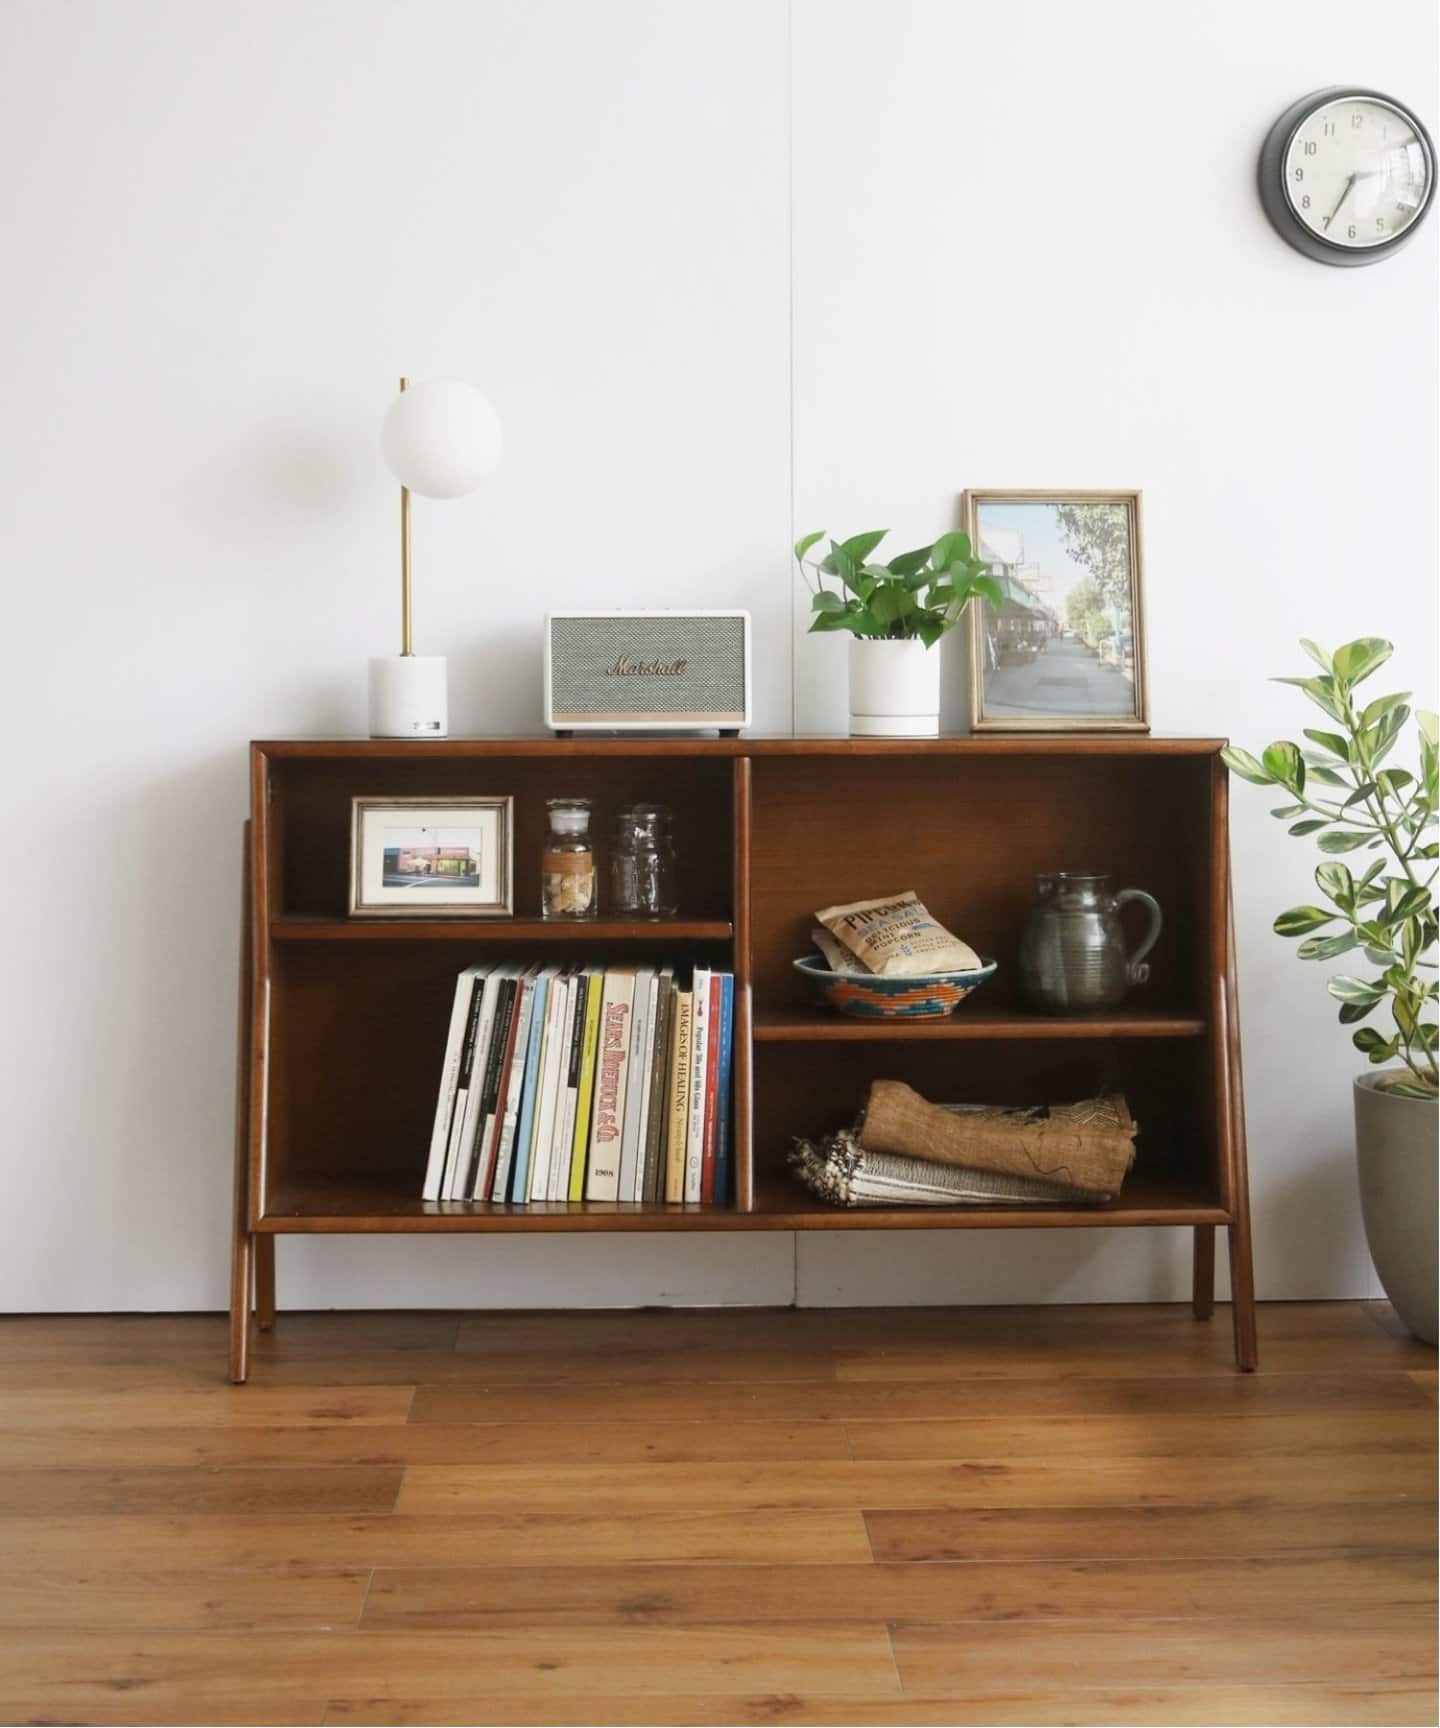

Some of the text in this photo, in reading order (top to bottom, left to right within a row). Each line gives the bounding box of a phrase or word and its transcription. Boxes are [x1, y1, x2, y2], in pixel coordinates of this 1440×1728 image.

[1351, 114, 1363, 129] 12
[1324, 123, 1335, 137] 11
[1304, 141, 1317, 155] 10
[1295, 167, 1304, 182] 9
[1302, 195, 1311, 209] 8
[1322, 216, 1331, 231] 7
[1376, 218, 1385, 232] 5
[1348, 225, 1357, 239] 6
[606, 655, 688, 677] Marshall
[873, 931, 921, 952] POPCORN
[680, 1003, 689, 1045] IMAGES
[679, 1044, 688, 1059] OF
[675, 1062, 687, 1113] HEALING
